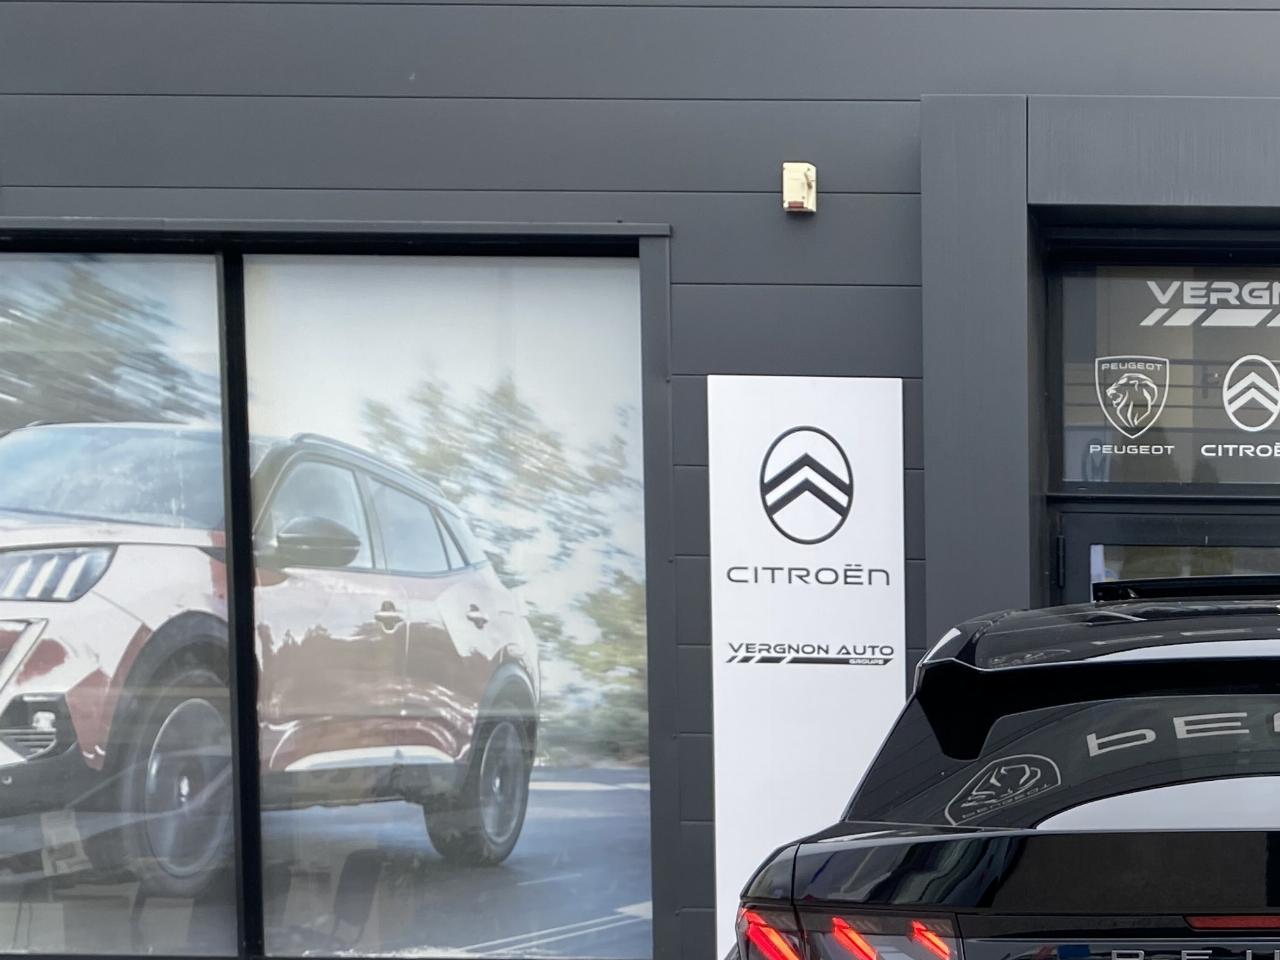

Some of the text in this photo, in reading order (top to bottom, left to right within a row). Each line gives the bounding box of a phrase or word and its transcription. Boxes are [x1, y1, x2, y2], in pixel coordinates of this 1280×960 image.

[1101, 361, 1163, 371] PEUGEOT
[1089, 444, 1175, 456] PEUGEOT
[726, 564, 890, 586] CITROËN
[728, 642, 895, 656] VERGNON AUTO
